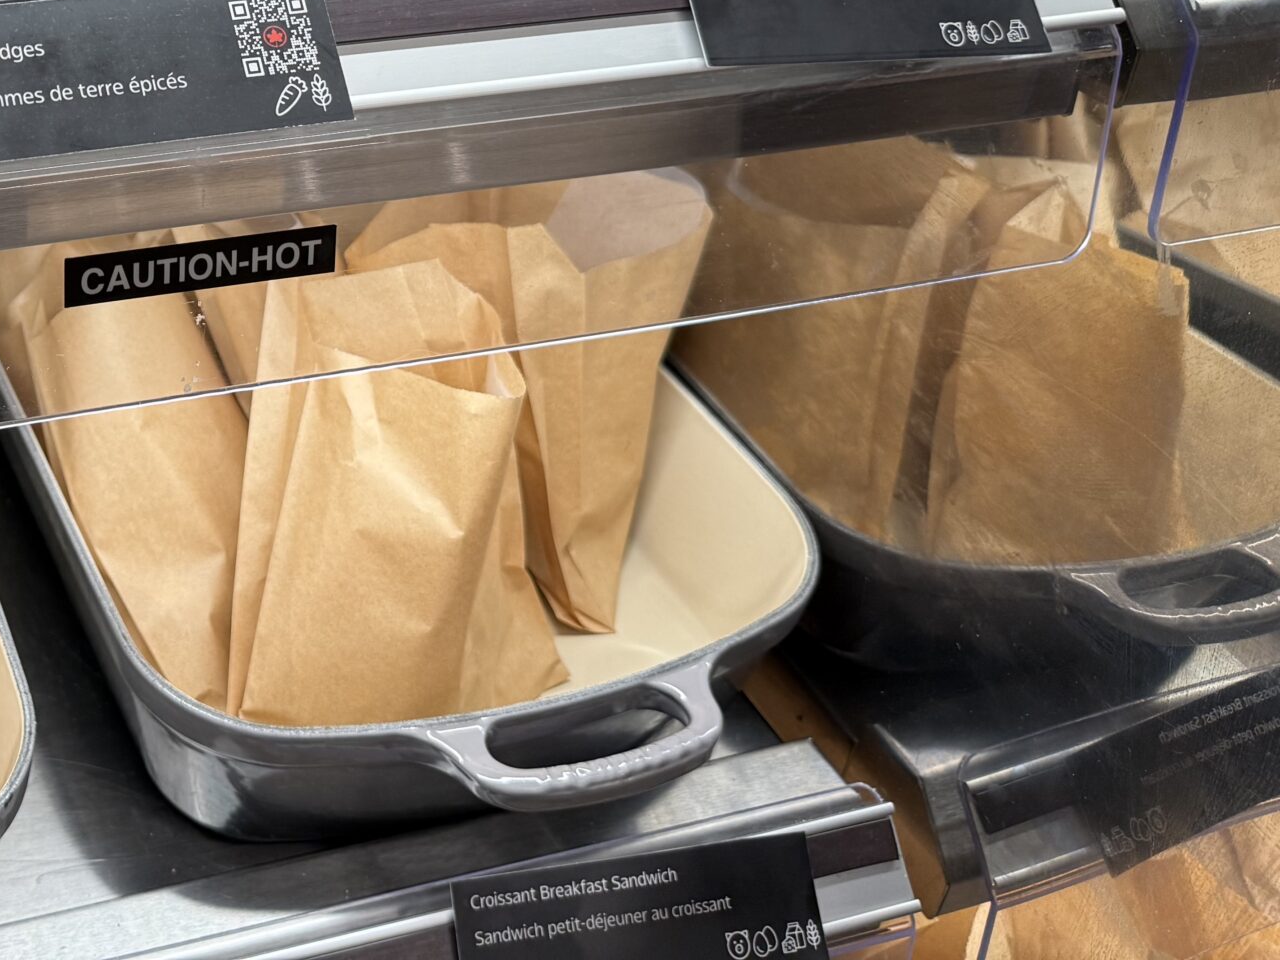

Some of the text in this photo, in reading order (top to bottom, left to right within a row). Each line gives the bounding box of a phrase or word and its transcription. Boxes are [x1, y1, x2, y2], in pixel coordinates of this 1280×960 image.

[49, 84, 74, 102] de
[77, 79, 124, 98] terre
[128, 72, 188, 97] épicés
[81, 239, 322, 295] CAUTION-HOT
[470, 867, 678, 910] Croissant Breakfast Sandwich
[474, 894, 732, 946] Sandwich petit-déjeuner au croissant
